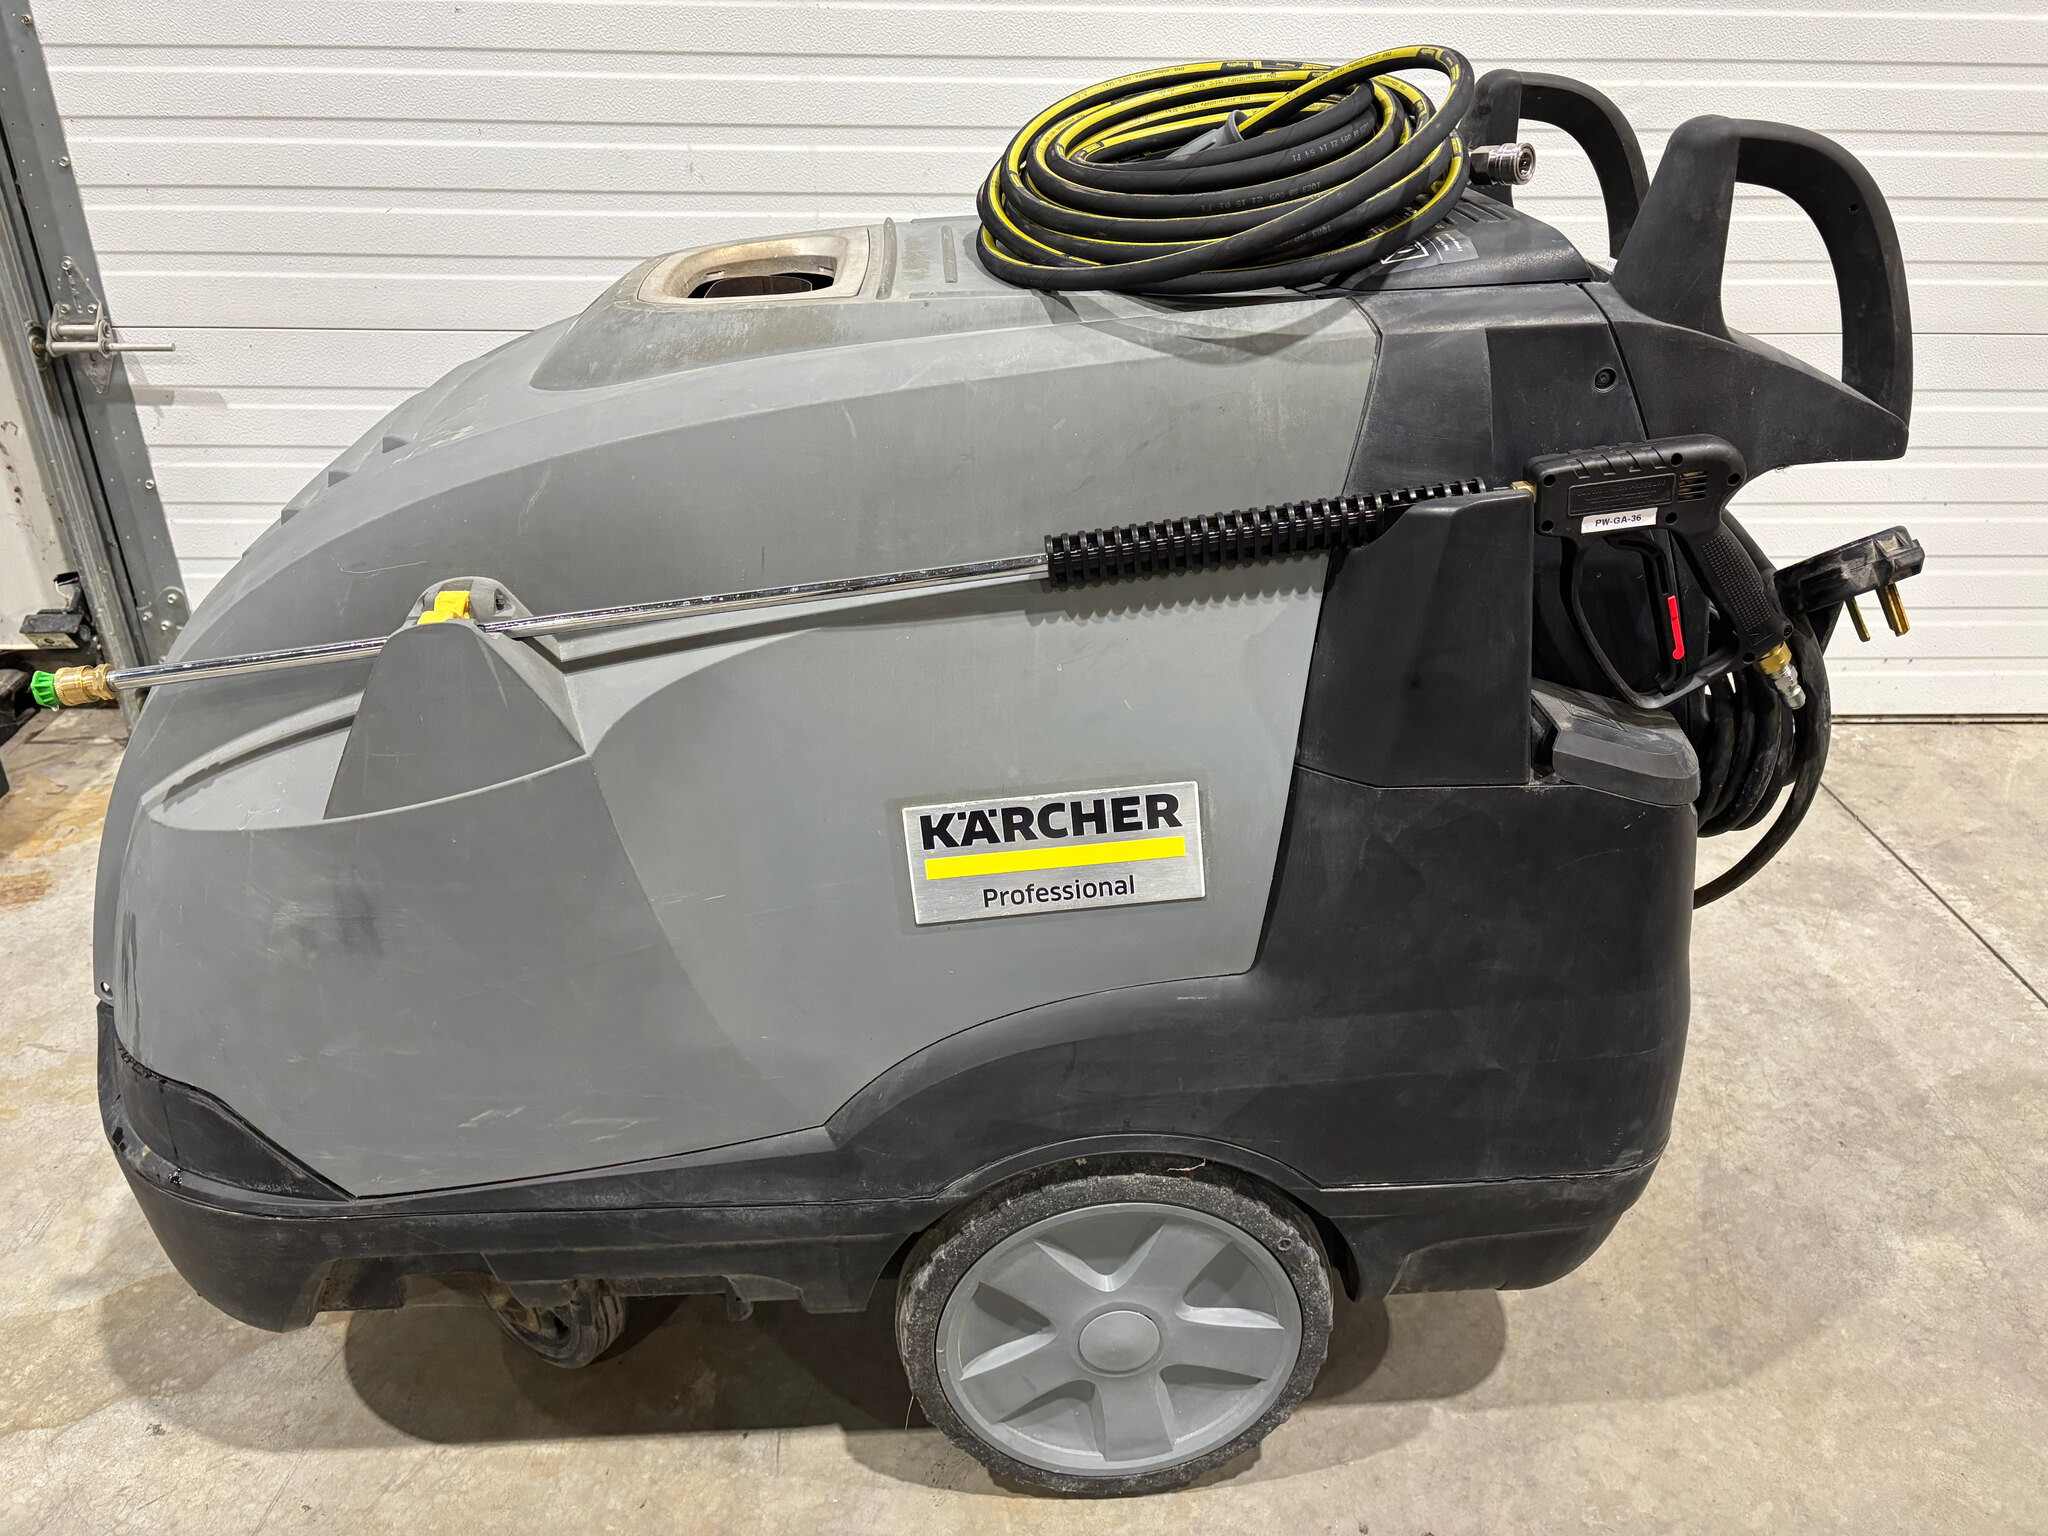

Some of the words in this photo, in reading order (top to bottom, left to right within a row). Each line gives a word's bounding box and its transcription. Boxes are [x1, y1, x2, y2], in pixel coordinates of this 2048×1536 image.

[1329, 138, 1339, 147] 21
[1304, 148, 1316, 157] 54
[1318, 143, 1328, 153] 14
[1236, 198, 1247, 208] 15
[1595, 514, 1642, 527] PW-GA-36
[919, 793, 1184, 851] KÄRCHER
[982, 874, 1135, 908] Professional
